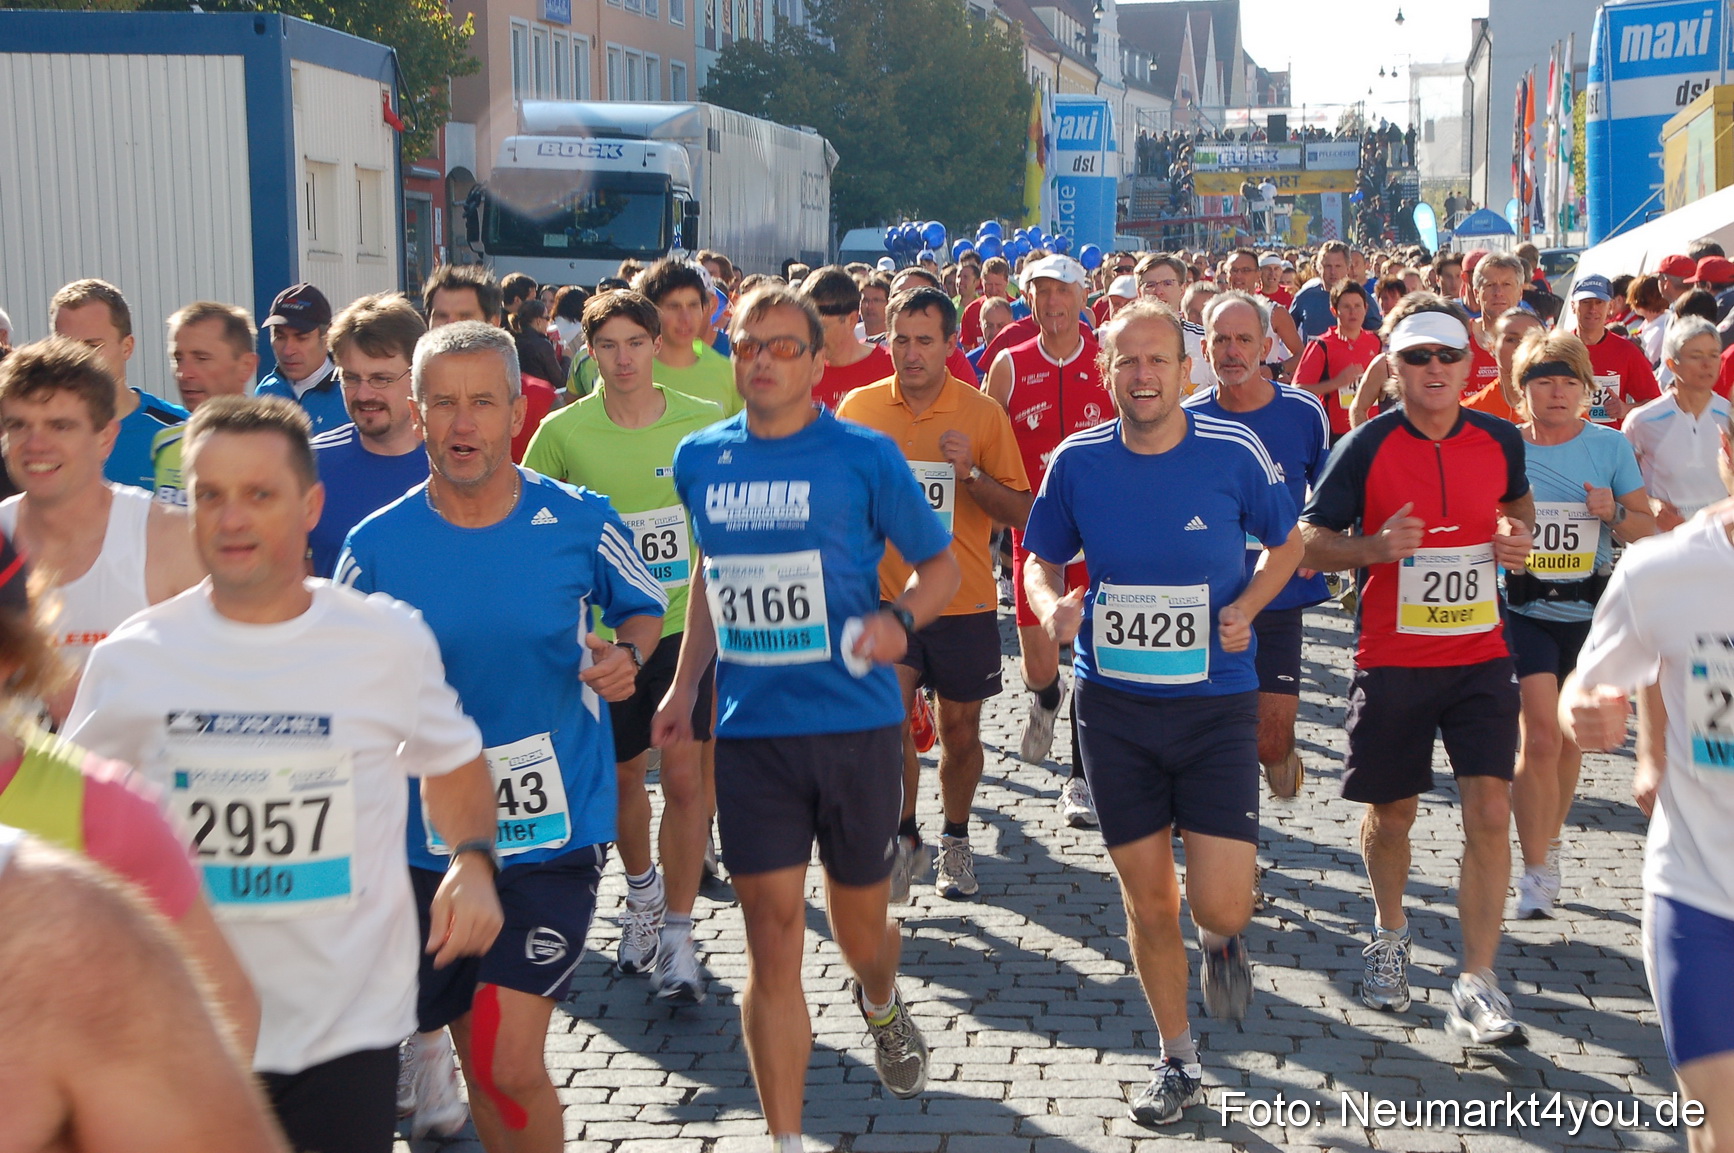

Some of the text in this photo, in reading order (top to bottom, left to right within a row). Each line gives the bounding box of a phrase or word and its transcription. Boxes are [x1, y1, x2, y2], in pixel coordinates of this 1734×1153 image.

[1619, 9, 1713, 63] maxi
[537, 141, 624, 160] BOCK
[1072, 155, 1095, 172] dsl
[641, 529, 678, 562] 63
[1531, 522, 1580, 551] 205
[647, 566, 672, 580] us
[1423, 568, 1479, 603] 208
[718, 584, 810, 624] 3166
[1107, 593, 1158, 604] PFLEIDERER
[1104, 610, 1196, 649] 3428
[1426, 606, 1475, 624] Xaver
[727, 628, 812, 649] Matthias
[497, 771, 548, 815] 43
[190, 796, 331, 857] 2957
[231, 866, 294, 896] Udo
